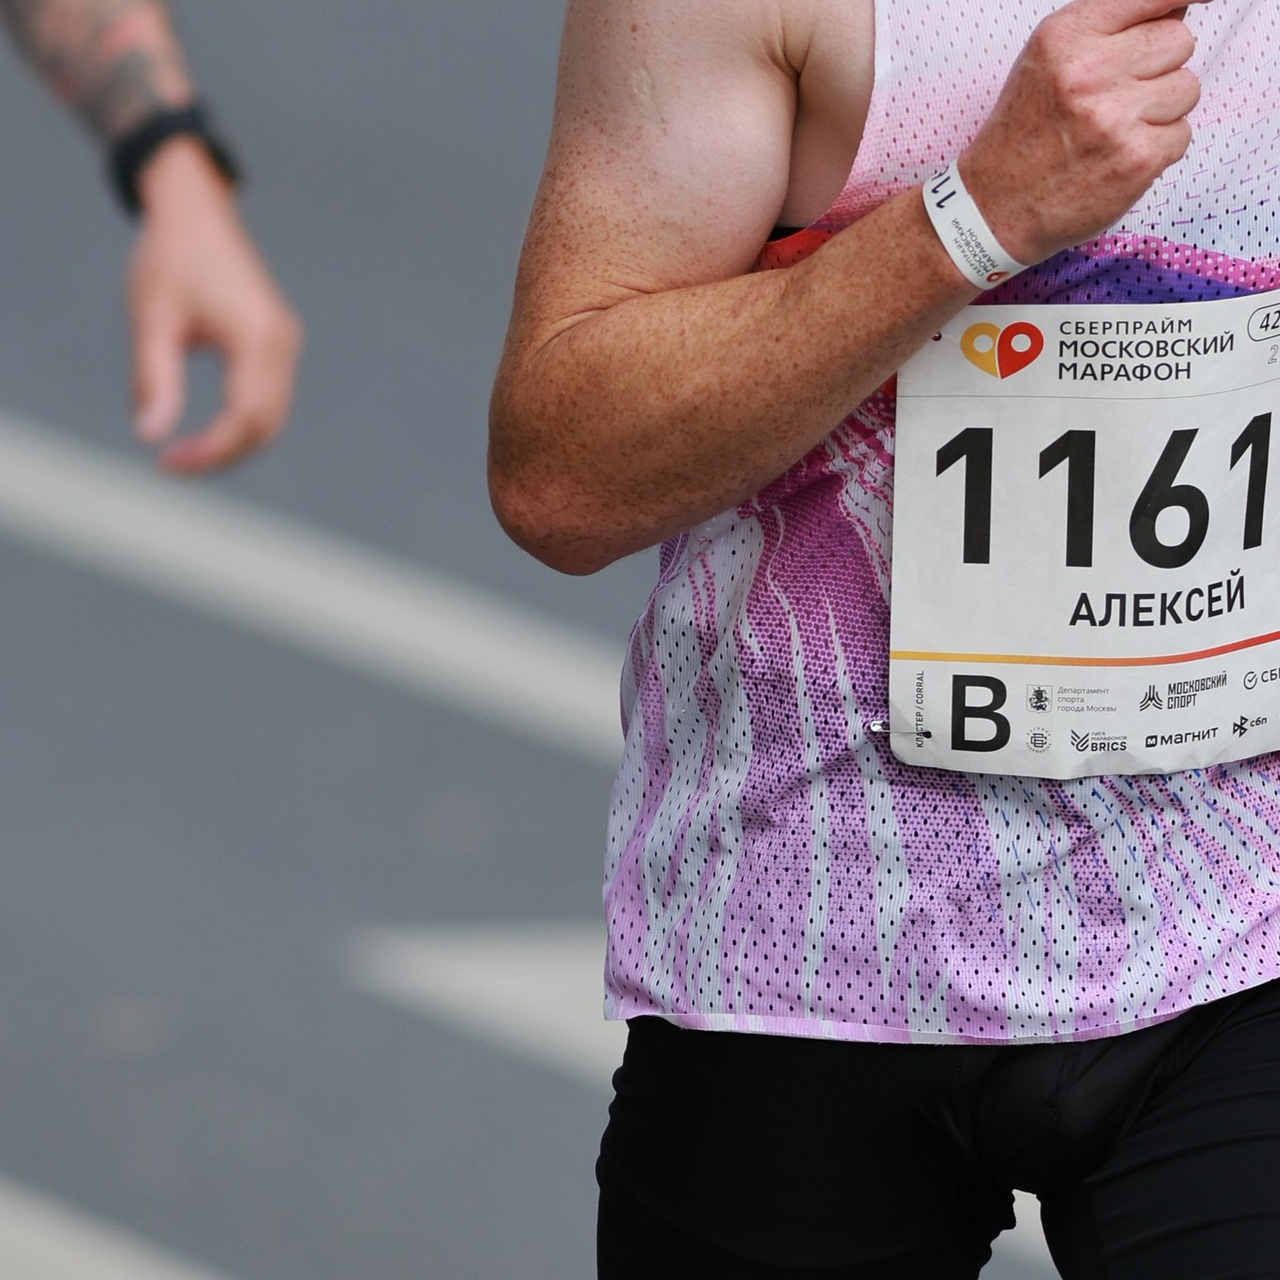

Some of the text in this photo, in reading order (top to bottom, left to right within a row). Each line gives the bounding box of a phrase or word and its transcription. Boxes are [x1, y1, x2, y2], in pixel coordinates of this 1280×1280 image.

[951, 218, 990, 273] МОСКОВСКИЙ
[967, 227, 999, 269] МАРАФОН
[1059, 316, 1192, 335] СБЕРПРАЙМ
[1059, 330, 1235, 359] МОСКОВСКИЙ
[1058, 361, 1191, 381] МАРАФОН
[1069, 568, 1246, 628] АЛЕКСЕЙ
[915, 670, 925, 705] CORRAL
[1057, 687, 1109, 695] Департамент
[1167, 670, 1228, 696] МОСКОВСКИЙ
[1057, 696, 1085, 704] спорта
[1057, 705, 1085, 713] города
[1167, 693, 1198, 710] СПОРТ
[1250, 716, 1268, 727] сбп
[1160, 727, 1219, 746] магнит
[1091, 741, 1128, 752] BRICS
